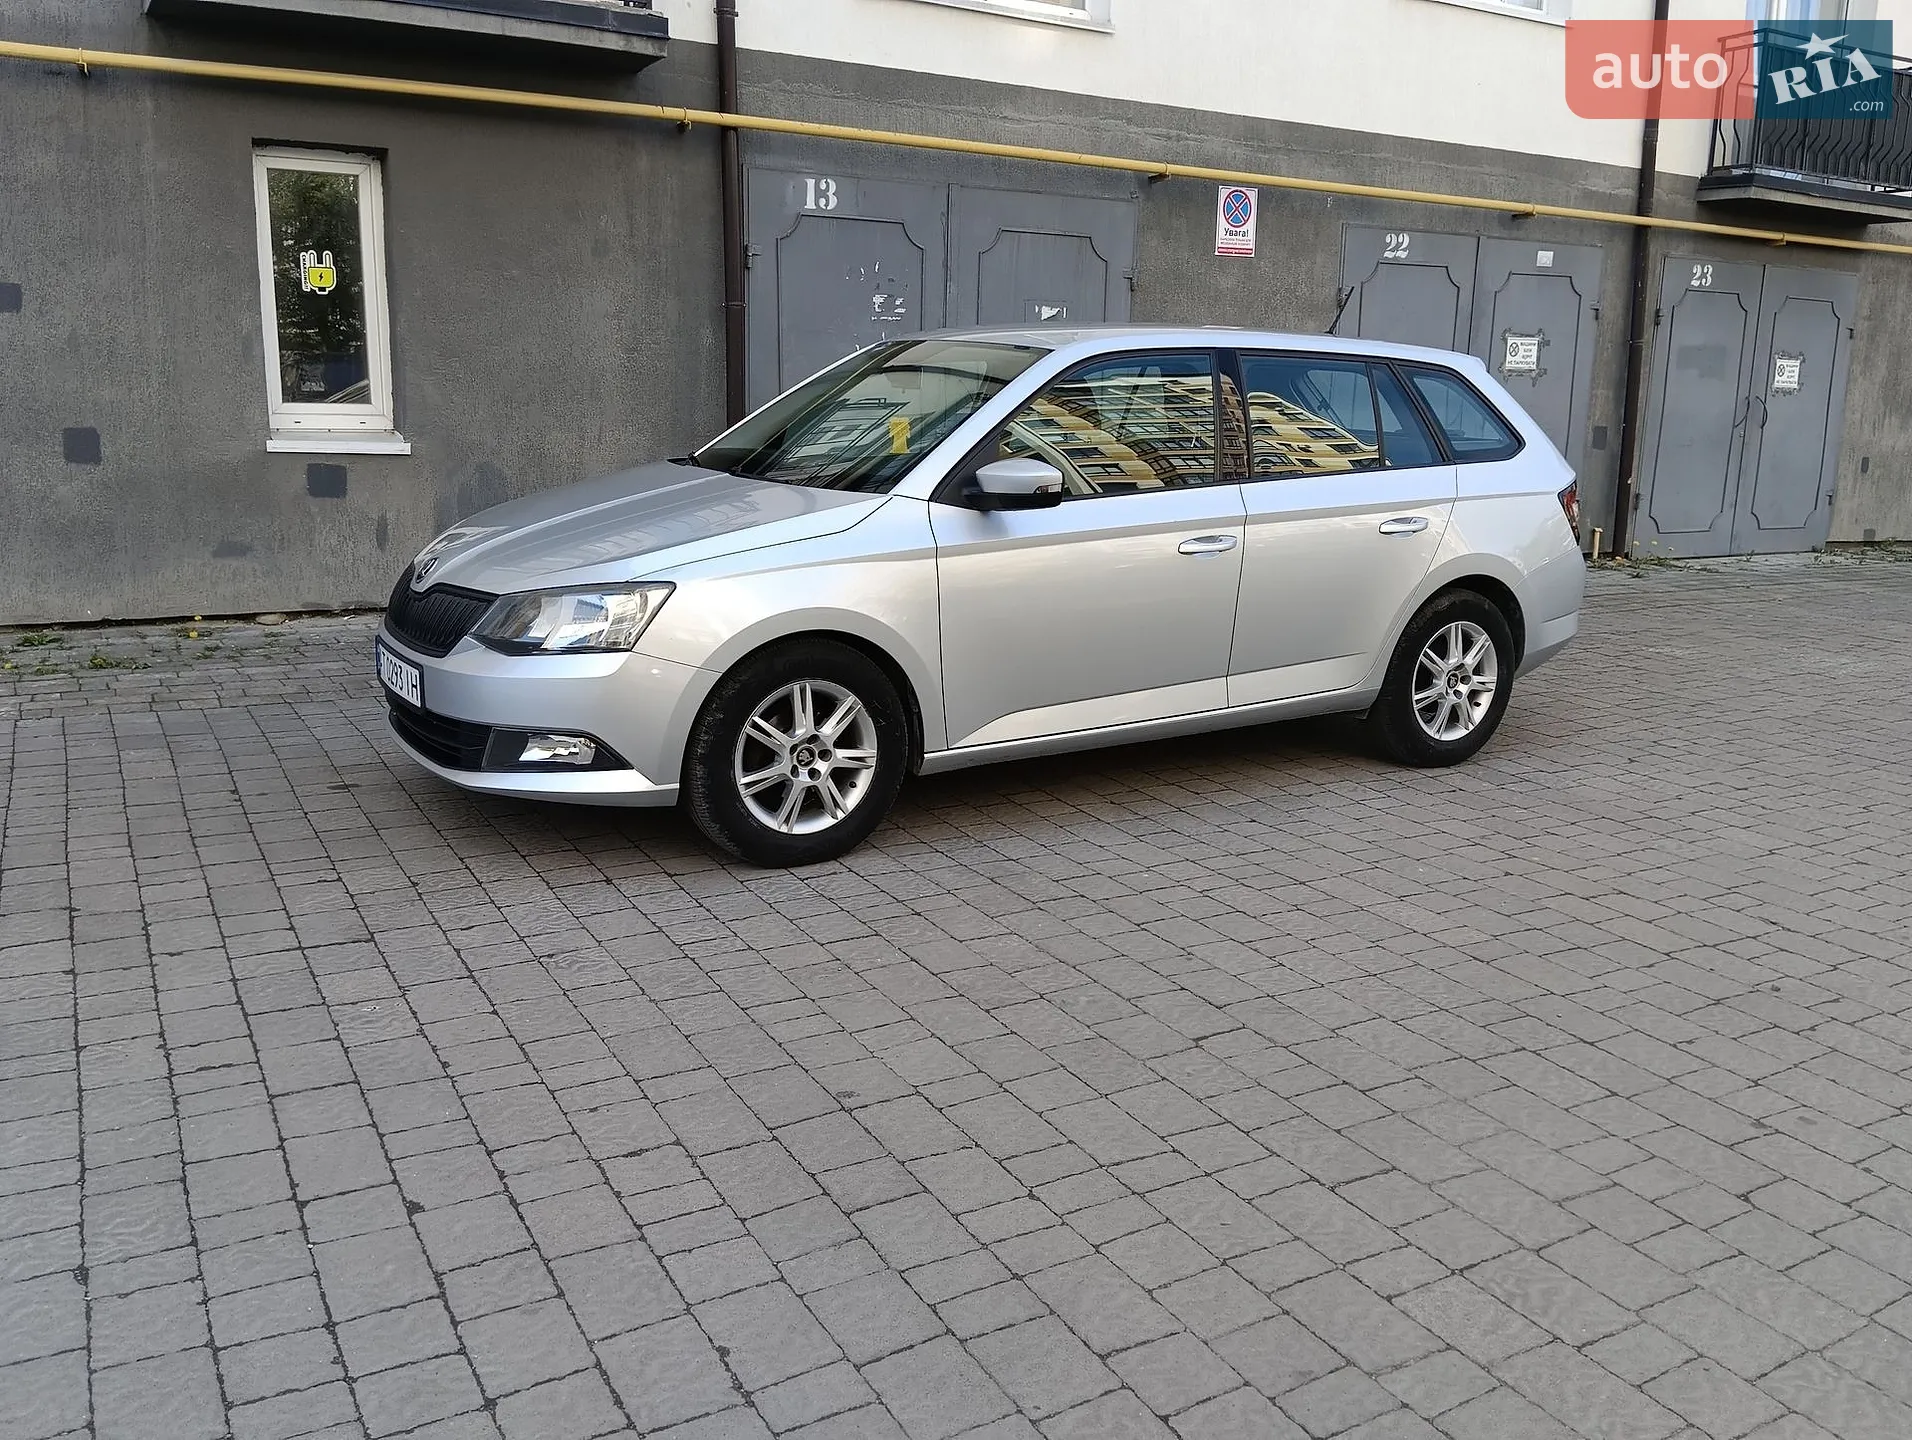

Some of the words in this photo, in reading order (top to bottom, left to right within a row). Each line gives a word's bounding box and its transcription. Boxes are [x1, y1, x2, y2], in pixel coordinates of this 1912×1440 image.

[804, 178, 838, 210] 13
[1224, 227, 1249, 238] Увага!
[1383, 233, 1410, 259] 22
[1690, 264, 1713, 287] 23
